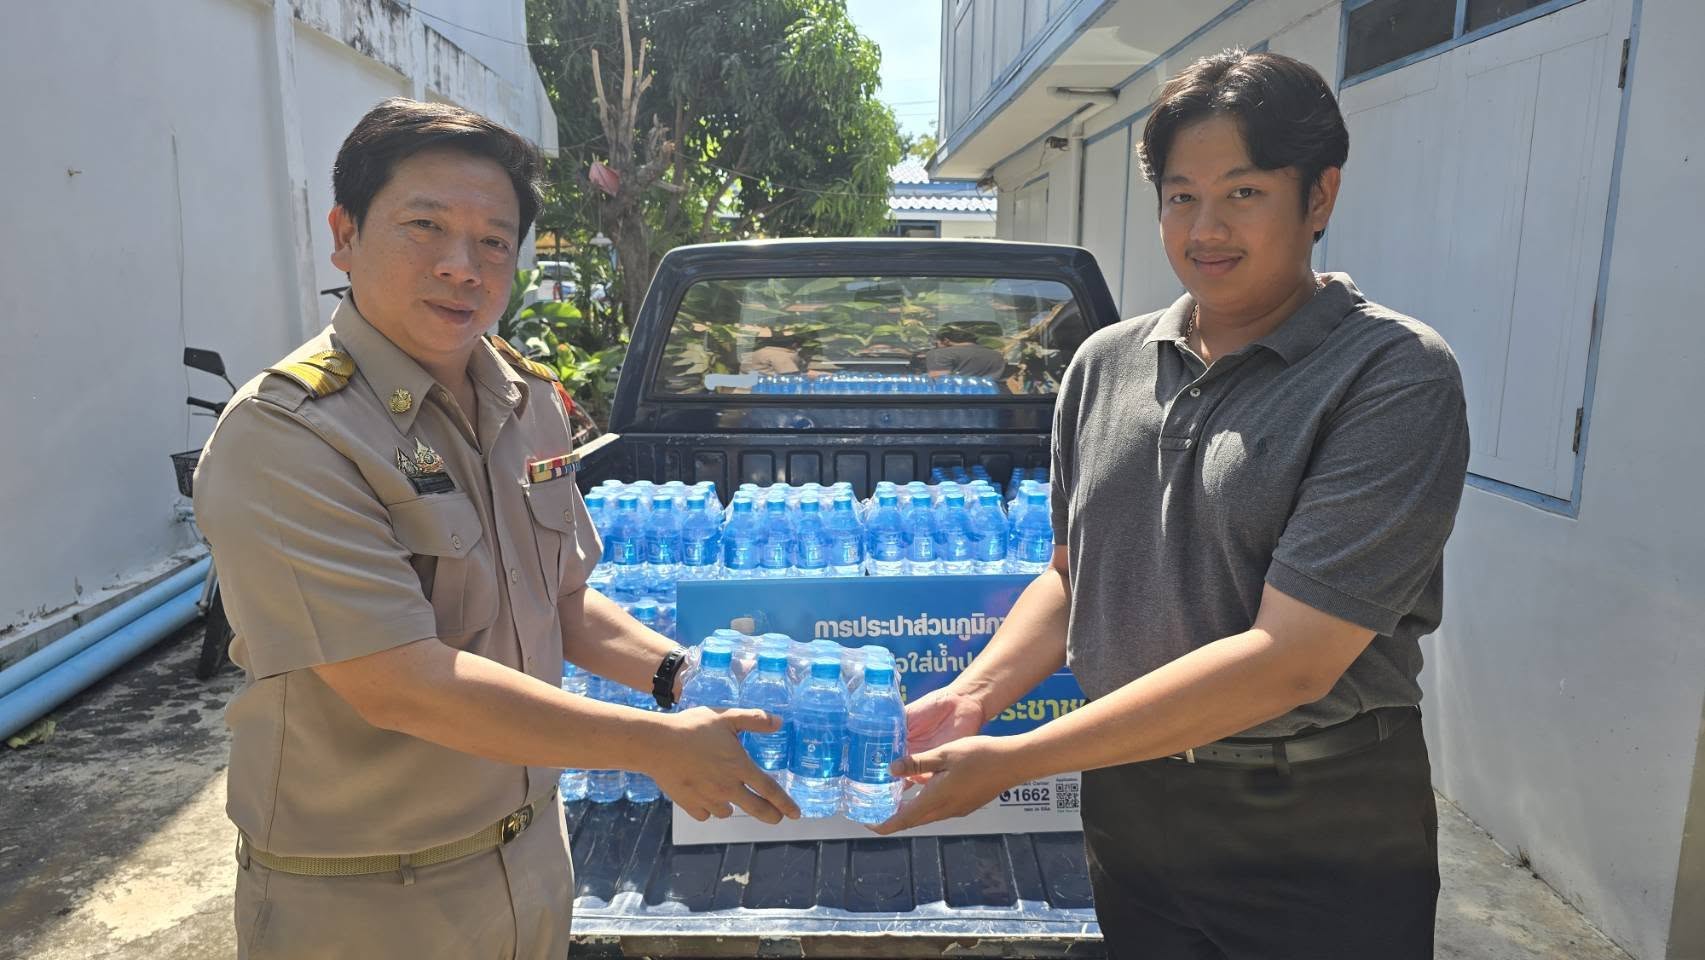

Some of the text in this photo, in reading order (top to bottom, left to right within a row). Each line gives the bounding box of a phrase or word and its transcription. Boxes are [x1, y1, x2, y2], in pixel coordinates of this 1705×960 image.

[815, 612, 1005, 641] การประปาส่วนภูมิภ
[990, 699, 1085, 722] ระชาช
[1013, 788, 1050, 802] 1662
